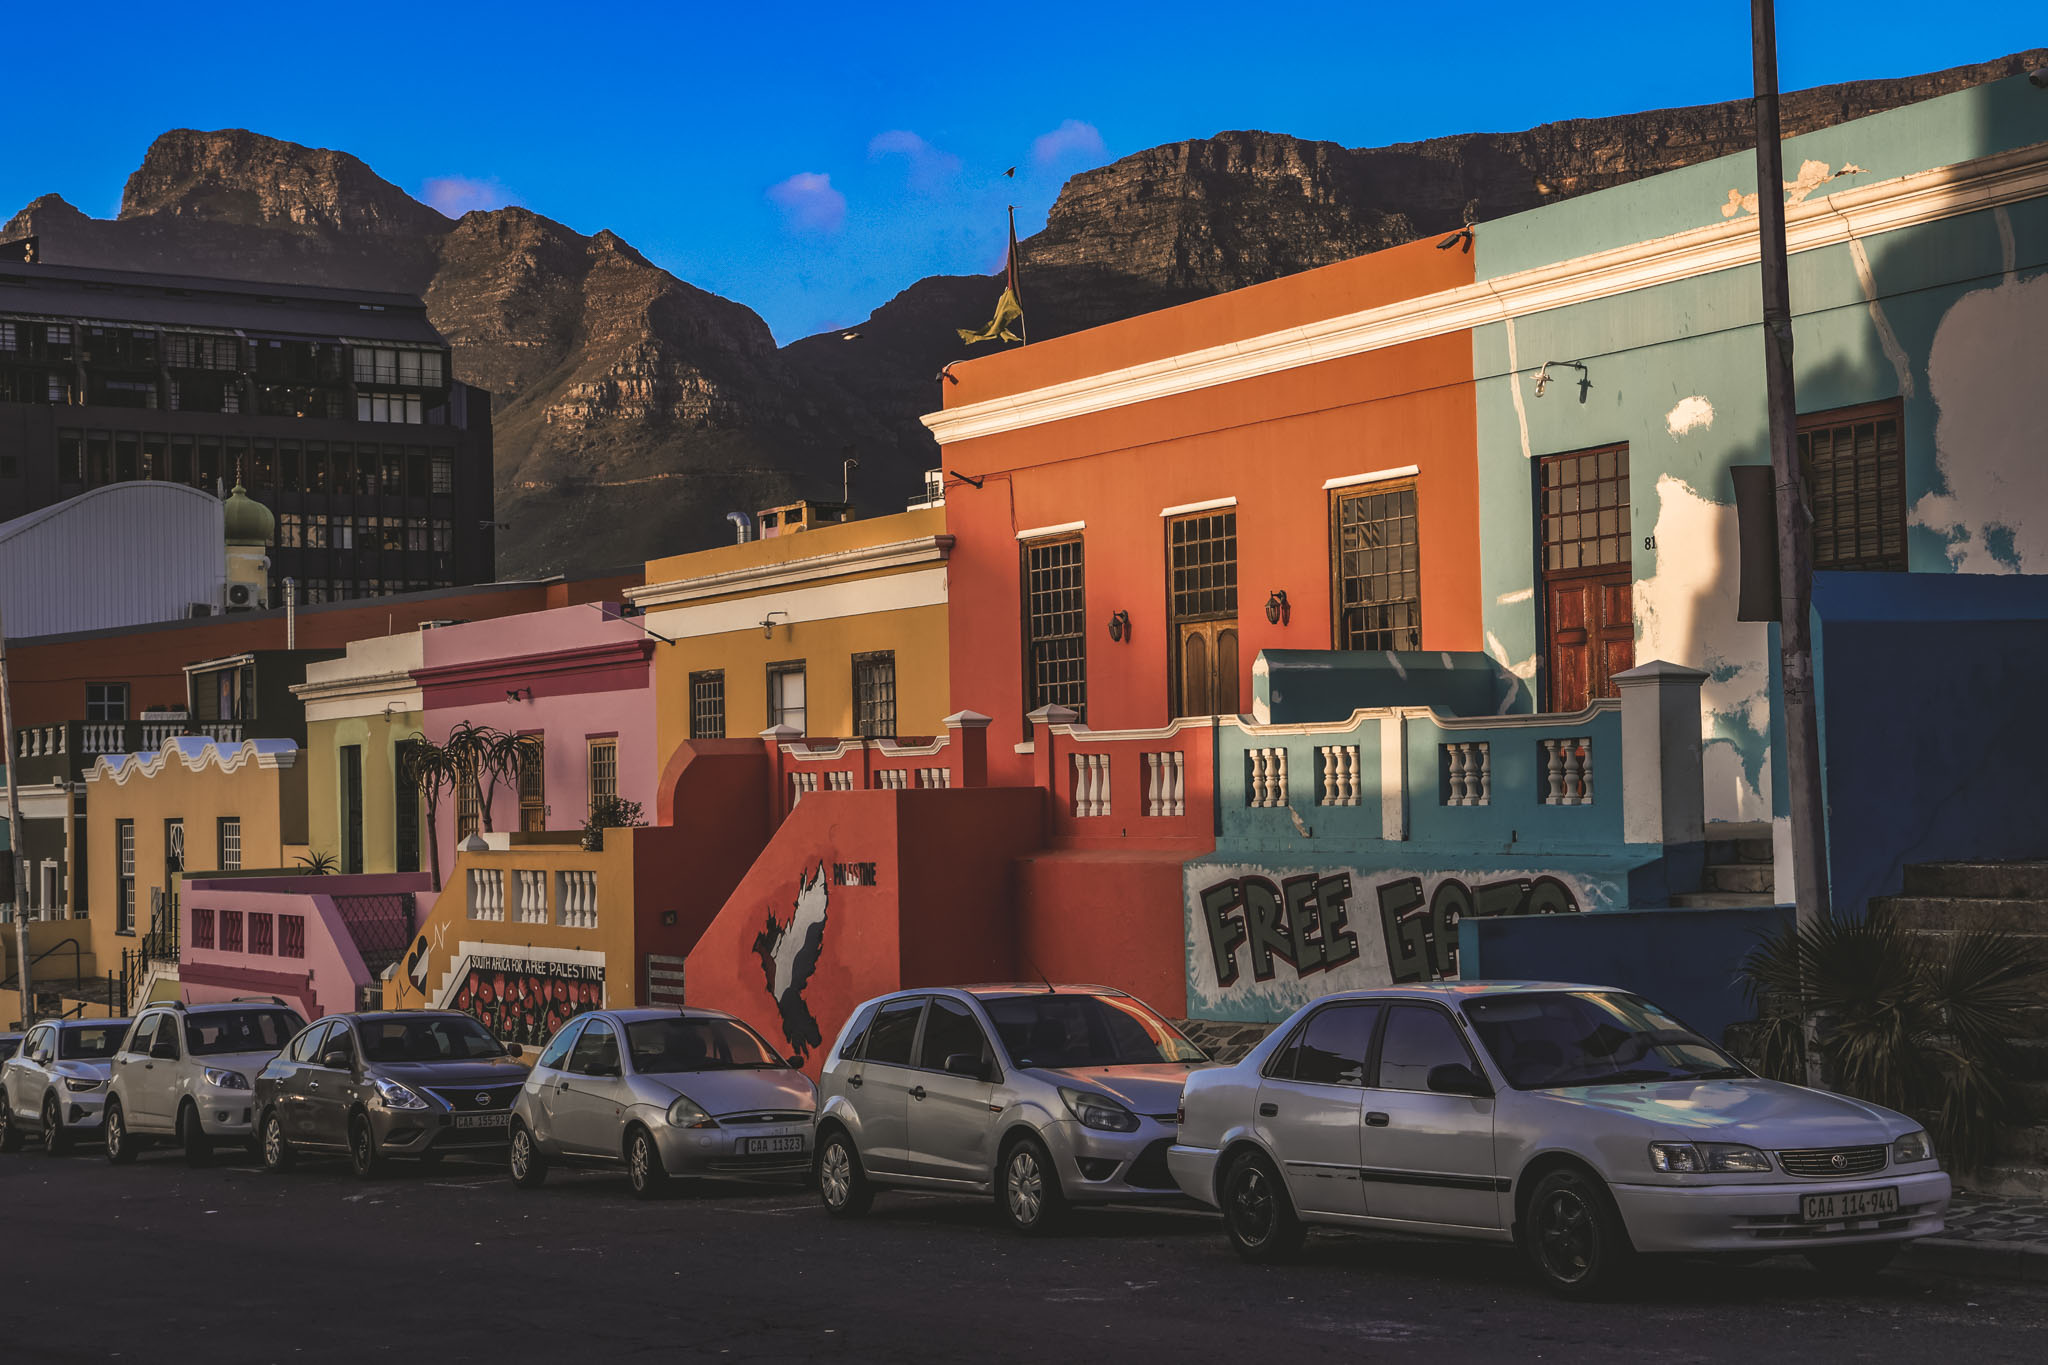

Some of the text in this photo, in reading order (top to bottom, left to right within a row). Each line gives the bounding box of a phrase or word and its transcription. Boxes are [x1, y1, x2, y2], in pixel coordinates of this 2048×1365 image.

[1644, 535, 1656, 550] 81
[833, 862, 876, 886] PALESTINE
[1200, 872, 1360, 988] FREE
[471, 955, 491, 970] SOUTH
[492, 957, 511, 973] AFRICA
[512, 959, 524, 974] FOR
[549, 962, 604, 981] PALESTINE
[458, 1117, 473, 1128] CAA
[751, 1137, 800, 1152] CAA 11323
[1808, 1191, 1893, 1218] CAA 114-944
